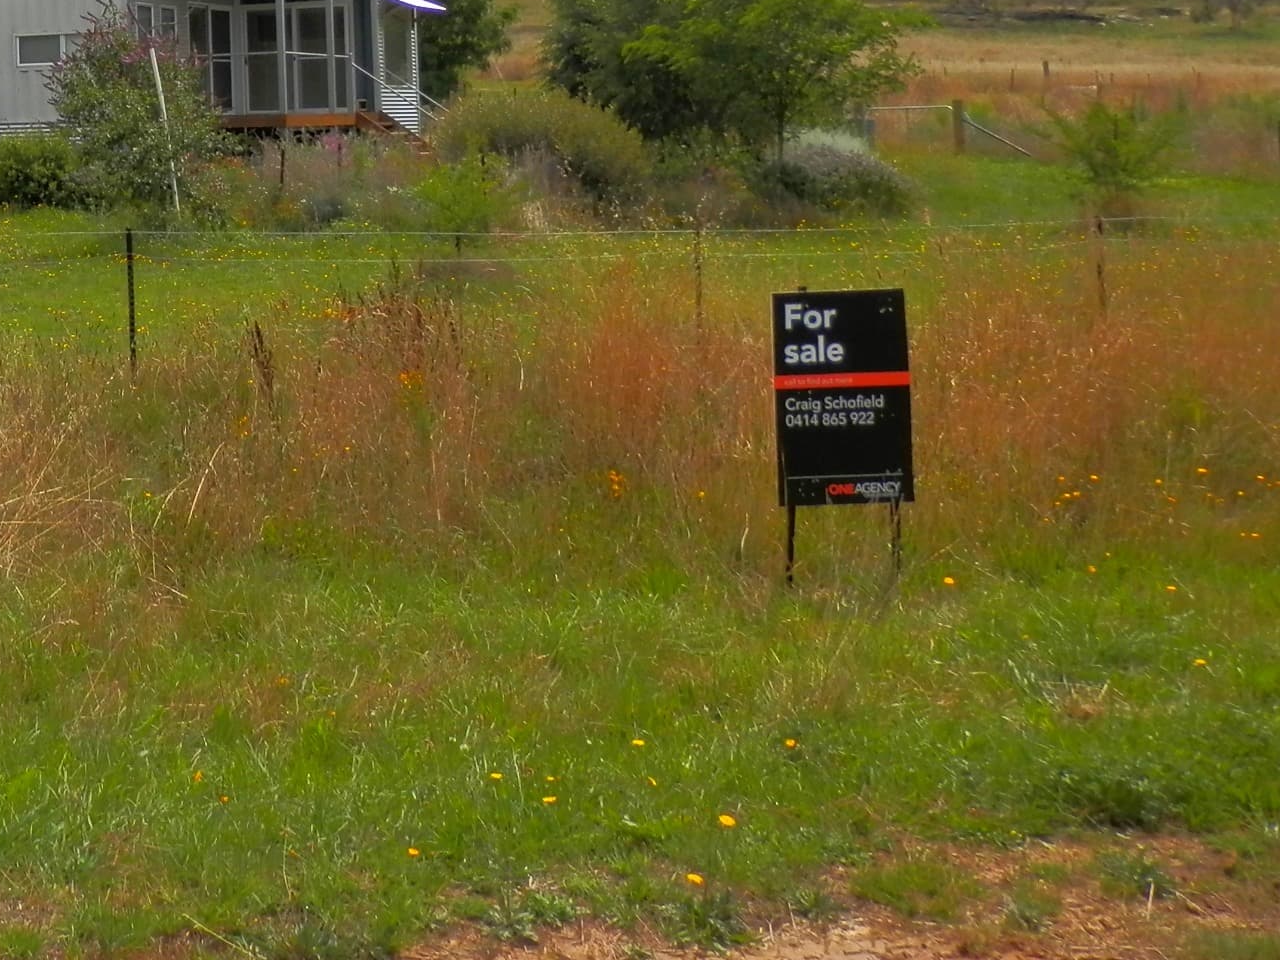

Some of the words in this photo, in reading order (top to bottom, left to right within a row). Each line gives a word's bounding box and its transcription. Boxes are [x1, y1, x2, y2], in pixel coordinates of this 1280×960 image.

[784, 303, 837, 330] For
[783, 335, 845, 364] sale
[784, 397, 821, 413] Craig
[823, 394, 885, 410] Schofield
[785, 414, 819, 427] 0414
[822, 412, 848, 426] 865
[849, 411, 875, 425] 922
